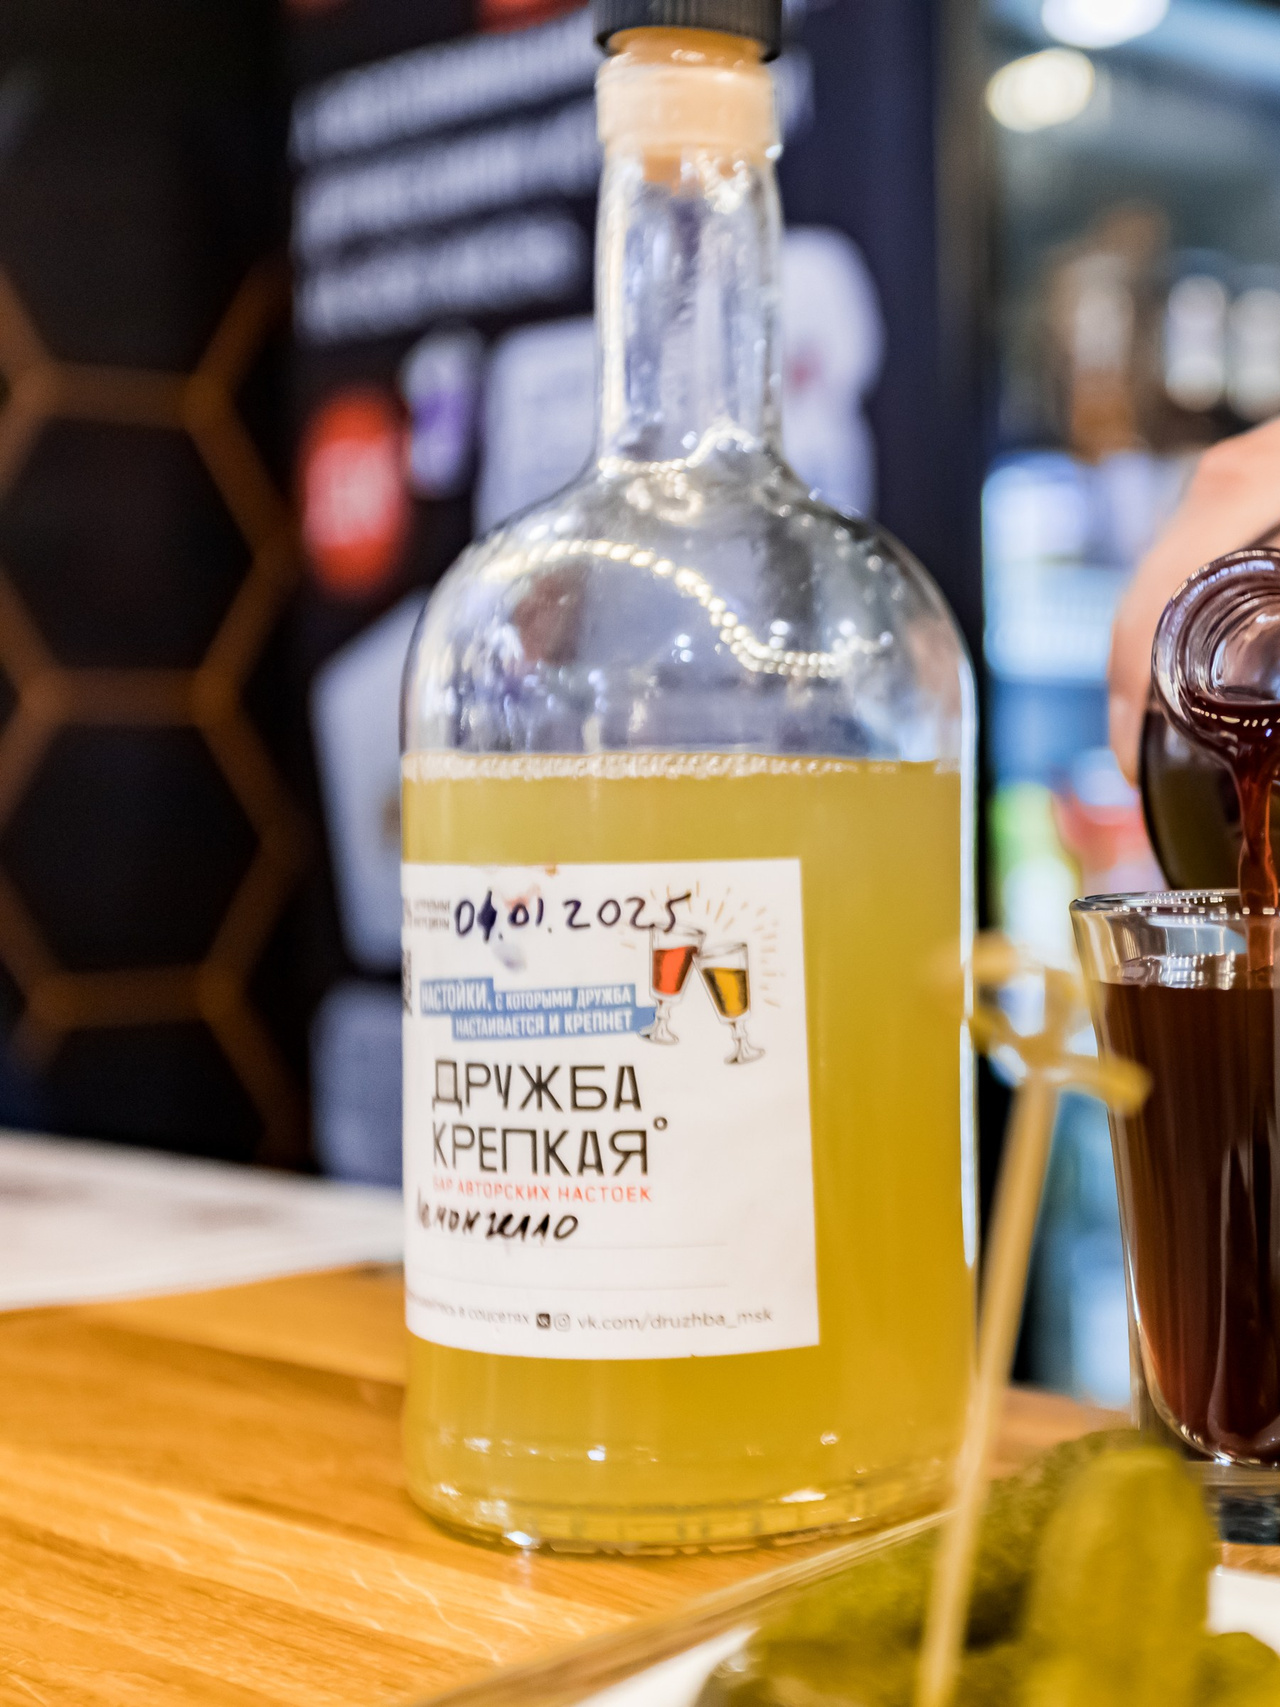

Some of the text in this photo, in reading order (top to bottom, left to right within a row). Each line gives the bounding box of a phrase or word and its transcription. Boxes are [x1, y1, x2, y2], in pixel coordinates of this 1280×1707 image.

[506, 990, 573, 1011] КОТОРЫМИ
[576, 985, 632, 1009] ДРУЖБА
[454, 1009, 634, 1038] НАСТАИВАЕТСЯ И КРЕПНЕТ
[431, 1058, 643, 1117] ДРУЖБА
[457, 1177, 552, 1203] АВТОРСКИХ
[557, 1184, 653, 1203] НАСТОЕК
